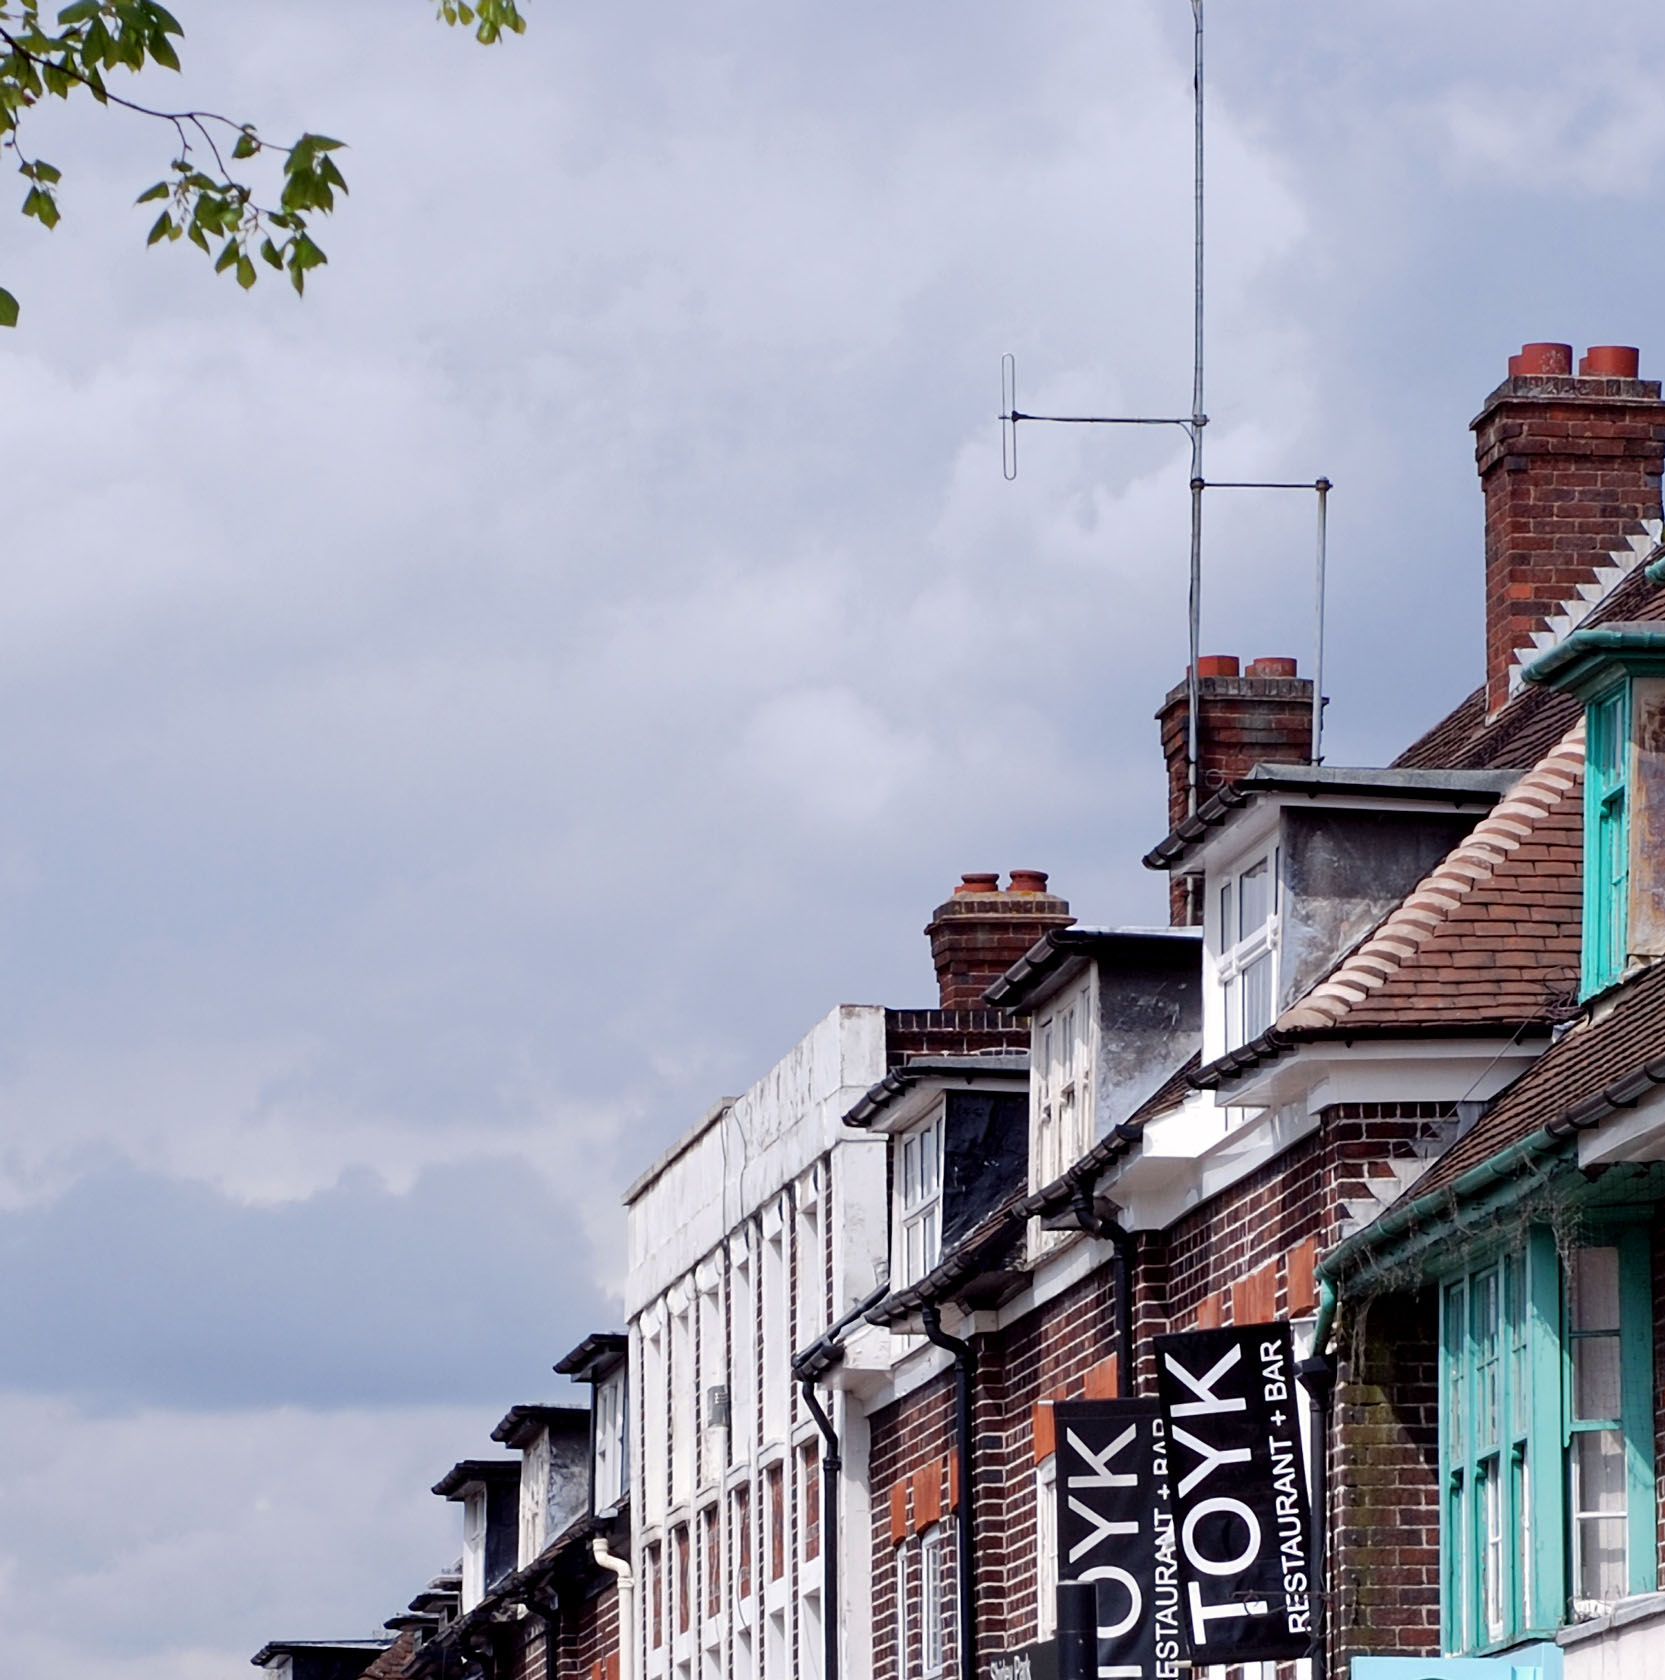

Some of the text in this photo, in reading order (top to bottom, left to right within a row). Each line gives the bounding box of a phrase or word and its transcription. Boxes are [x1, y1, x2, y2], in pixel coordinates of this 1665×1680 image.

[1260, 1339, 1288, 1402] BAR
[1164, 1343, 1268, 1646] TOYK
[1270, 1435, 1312, 1634] RESTAURANT
